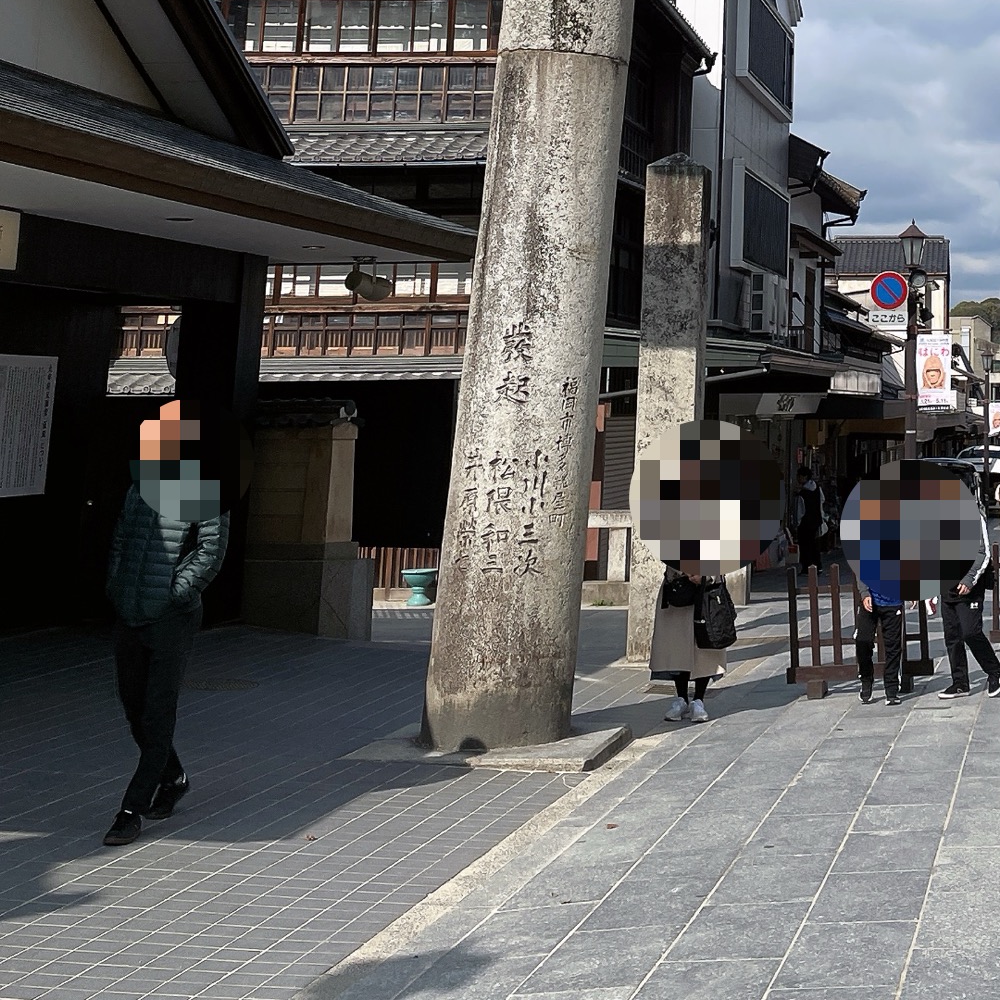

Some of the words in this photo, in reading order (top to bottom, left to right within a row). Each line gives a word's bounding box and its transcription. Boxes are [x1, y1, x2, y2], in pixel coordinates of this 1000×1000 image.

[871, 314, 906, 323] ここから
[918, 347, 950, 357] はにわ
